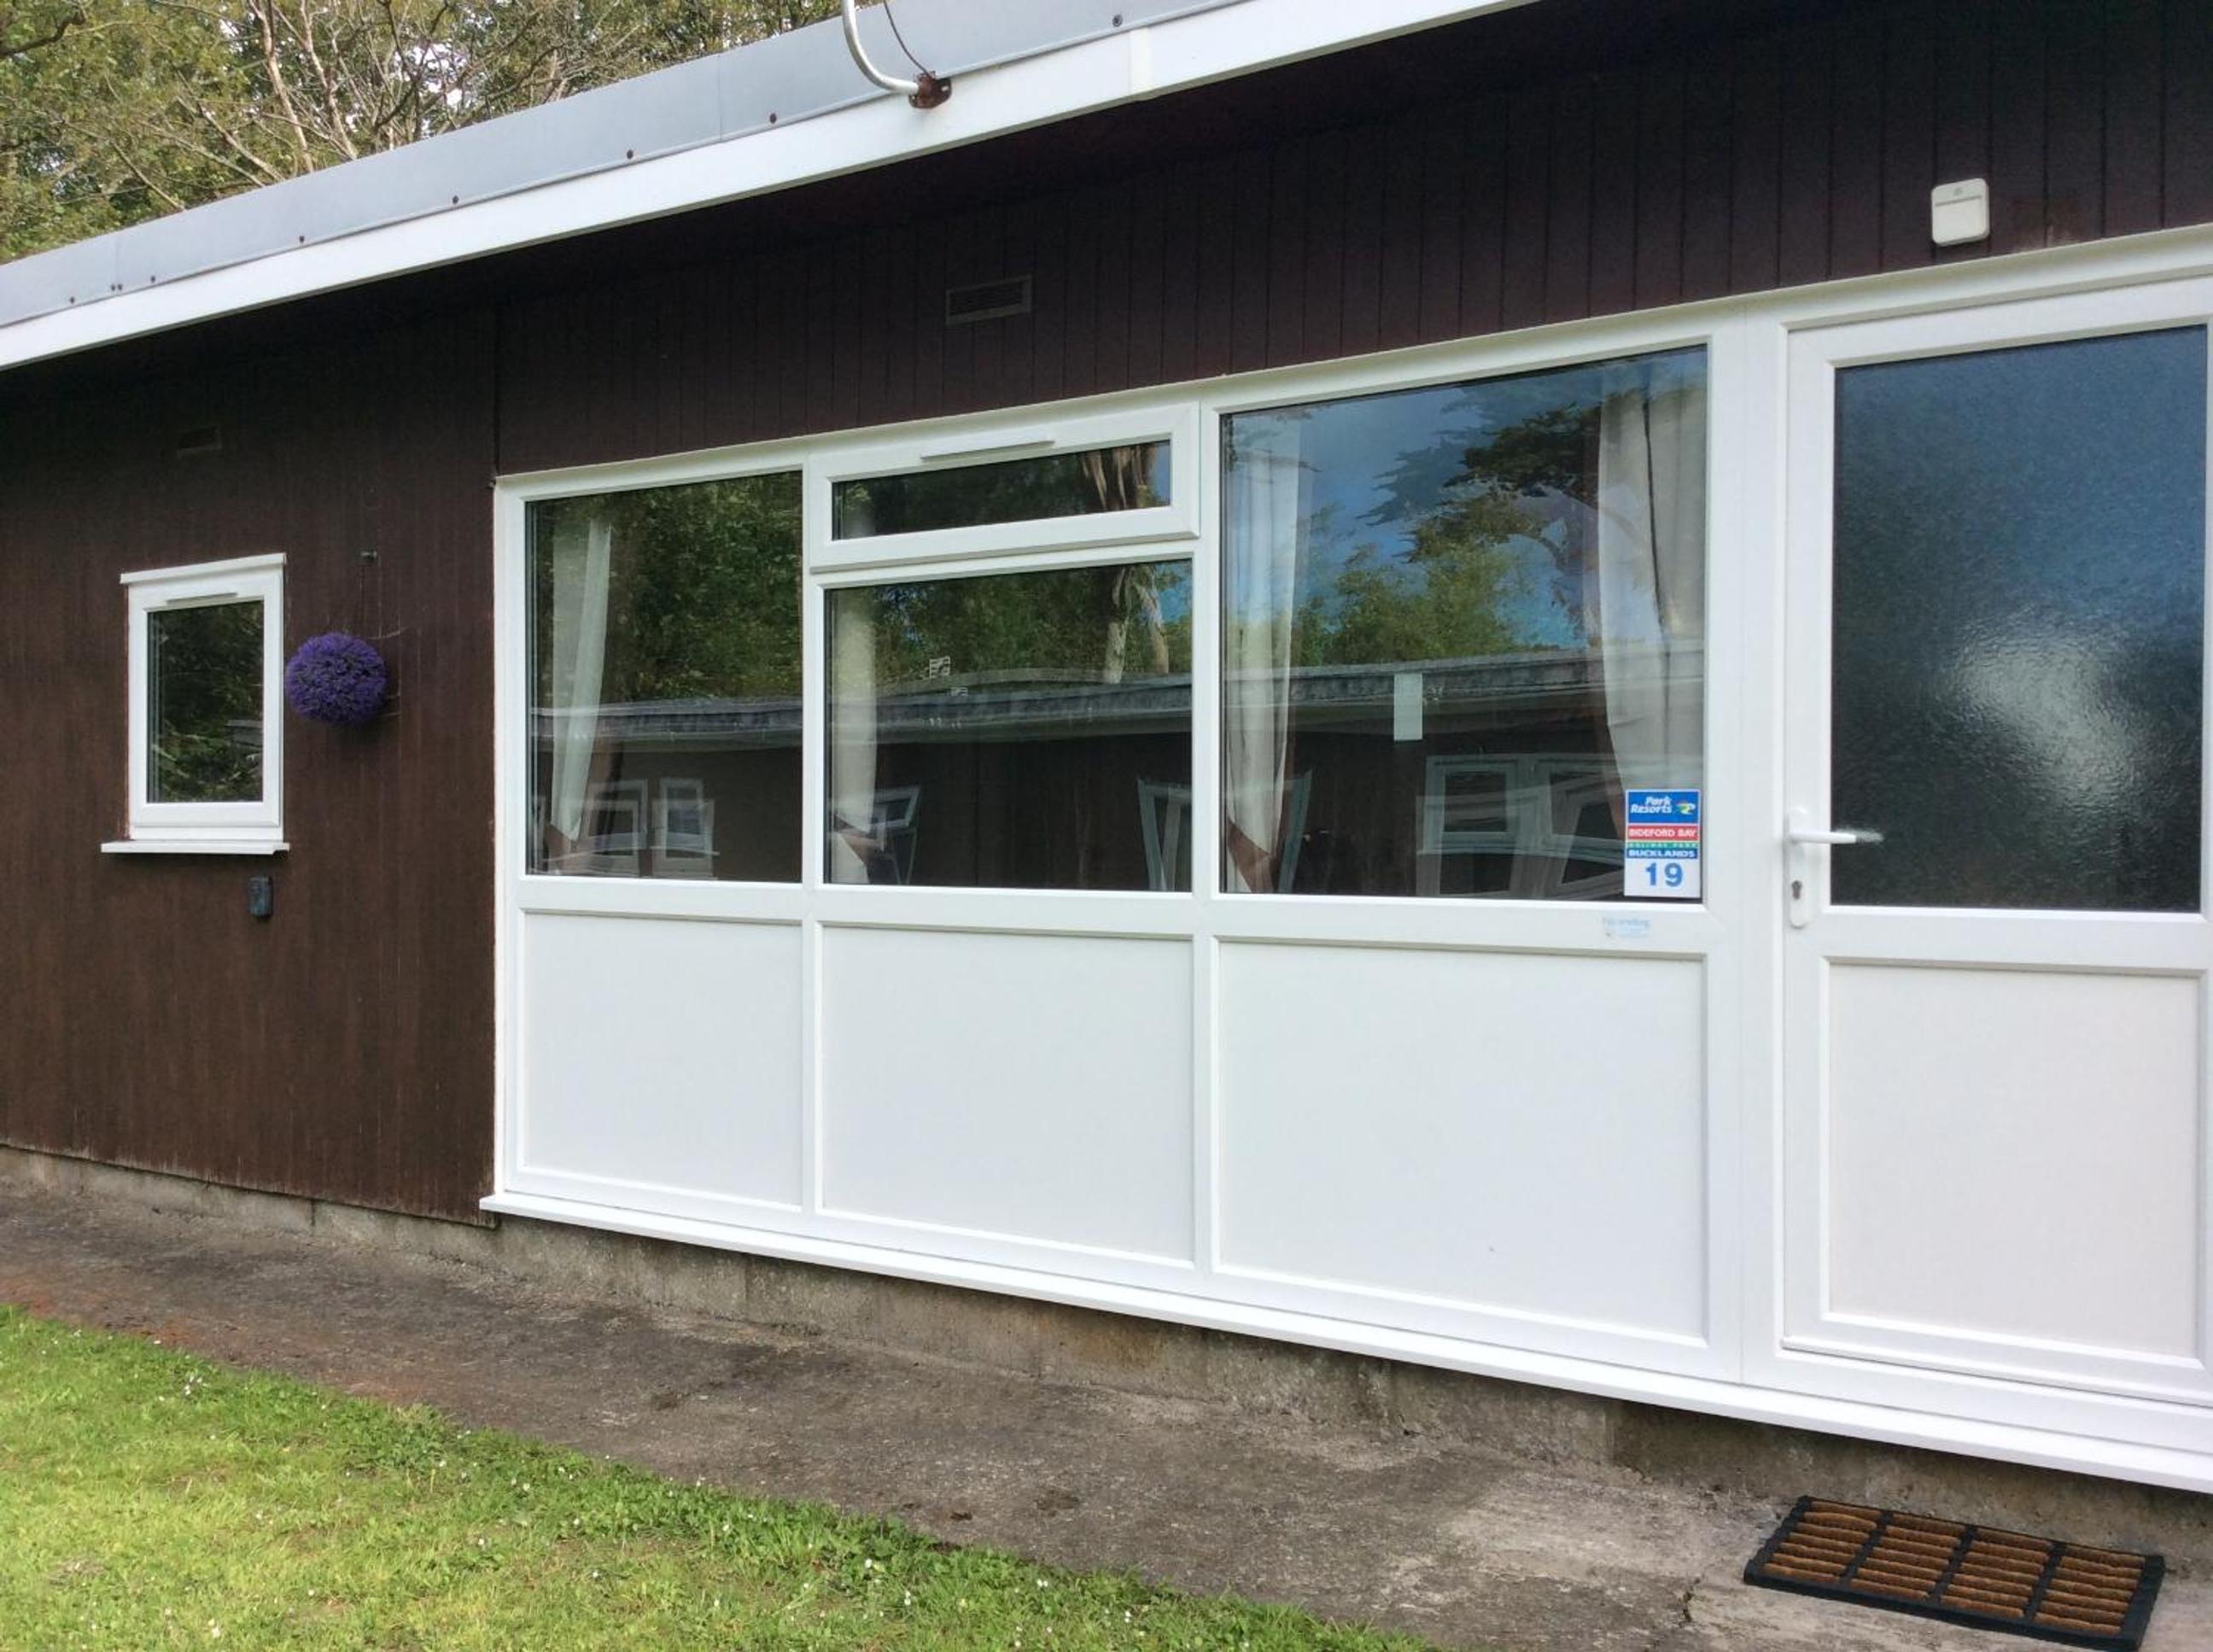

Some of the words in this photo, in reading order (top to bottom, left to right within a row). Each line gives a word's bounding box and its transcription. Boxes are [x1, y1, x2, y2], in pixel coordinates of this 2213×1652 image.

[1645, 796, 1672, 805] Park
[1631, 804, 1673, 814] Resorts
[1629, 828, 1675, 838] BIDEFORD
[1678, 828, 1696, 838] BAY
[1628, 849, 1695, 858] BUCKLANDS
[1645, 862, 1683, 887] 19
